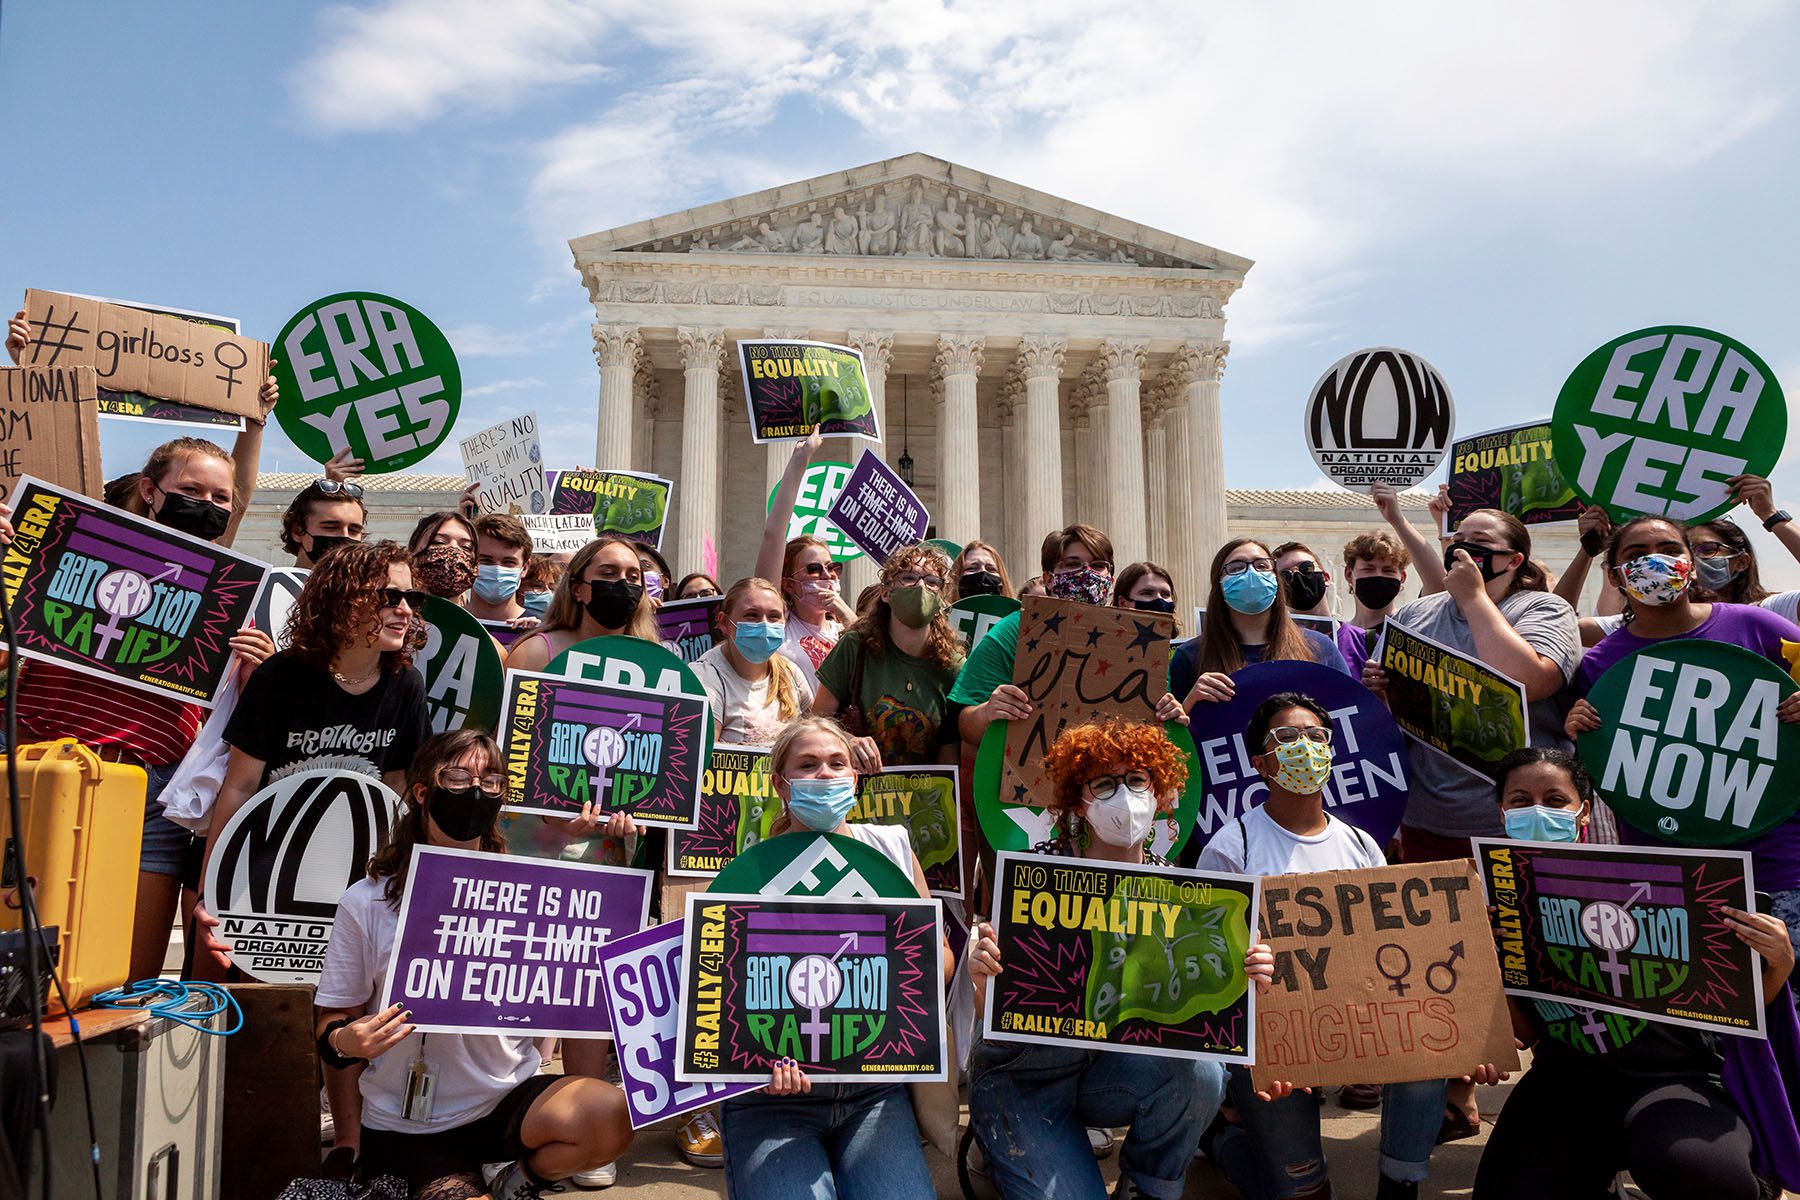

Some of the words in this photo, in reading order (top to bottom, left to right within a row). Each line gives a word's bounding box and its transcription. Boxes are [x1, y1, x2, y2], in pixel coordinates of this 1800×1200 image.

[798, 291, 856, 305] EQUAL
[863, 293, 927, 307] JUSTICE
[938, 295, 993, 309] UNDER
[1000, 298, 1034, 311] LAW
[29, 304, 205, 377] #girlboss
[284, 299, 425, 402] ERA
[748, 346, 768, 358] NO
[770, 346, 800, 358] TIME
[0, 367, 96, 403] TIONAL
[751, 359, 839, 379] EQUALITY
[1590, 333, 1766, 443] ERA
[299, 374, 451, 462] YES
[1310, 350, 1451, 450] NOW
[460, 425, 507, 461] THERE'S
[511, 415, 534, 438] NO
[465, 461, 491, 483] TIME
[496, 437, 531, 469] LIMIT
[1321, 453, 1436, 463] NATIONAL
[1455, 440, 1553, 475] EQUALITY
[1476, 434, 1508, 450] TIME
[561, 476, 638, 501] EQUALITY
[795, 466, 853, 511] ER
[1330, 466, 1425, 475] ORGANIZATION
[1344, 476, 1367, 484] FOR
[1367, 476, 1412, 485] WOMEN
[1572, 423, 1749, 522] YES
[839, 495, 857, 522] ON
[857, 482, 888, 518] TIME
[884, 508, 918, 546] LIMIT
[867, 467, 898, 504] THERE
[895, 494, 907, 513] IS
[904, 504, 919, 525] NO
[533, 537, 589, 550] TRIARCHY
[139, 673, 208, 699] GENERATIONRATIFY.ORG
[1017, 648, 1158, 711] era
[1384, 644, 1483, 706] EQUALITY
[1619, 654, 1781, 761] ERA
[507, 680, 539, 803] #RALLY4ERA
[1201, 705, 1360, 786] ELT
[1600, 728, 1775, 829] NOW
[633, 812, 690, 823] GENERATIONRATIFY.ORG
[846, 791, 915, 821] ALITY
[680, 855, 730, 870] #RALLY4
[451, 877, 532, 915] THERE
[537, 885, 562, 917] IS
[568, 889, 603, 921] NO
[1014, 865, 1047, 889] NO
[1053, 870, 1107, 895] TIME
[1113, 875, 1175, 901] LIMIT
[1179, 881, 1213, 905] ON
[223, 920, 326, 938] NATIO
[1011, 889, 1182, 938] EQUALITY
[1488, 848, 1529, 985] #RALLY4ERA
[234, 940, 328, 956] ORGANIZA
[252, 957, 285, 968] FOR
[436, 915, 517, 959] TIME
[523, 922, 612, 966] LIMIT
[404, 958, 455, 1000] ON
[461, 961, 602, 1008] EQUALIT
[693, 904, 727, 1068] #RALLY4ERA
[1001, 1012, 1108, 1040] #RALLY4ERA
[1260, 997, 1460, 1066] RIGHTS
[1666, 1007, 1751, 1027] GENERATIONRATIFY.ORG
[861, 1063, 935, 1073] GENERATIONRATIFY.ORG
